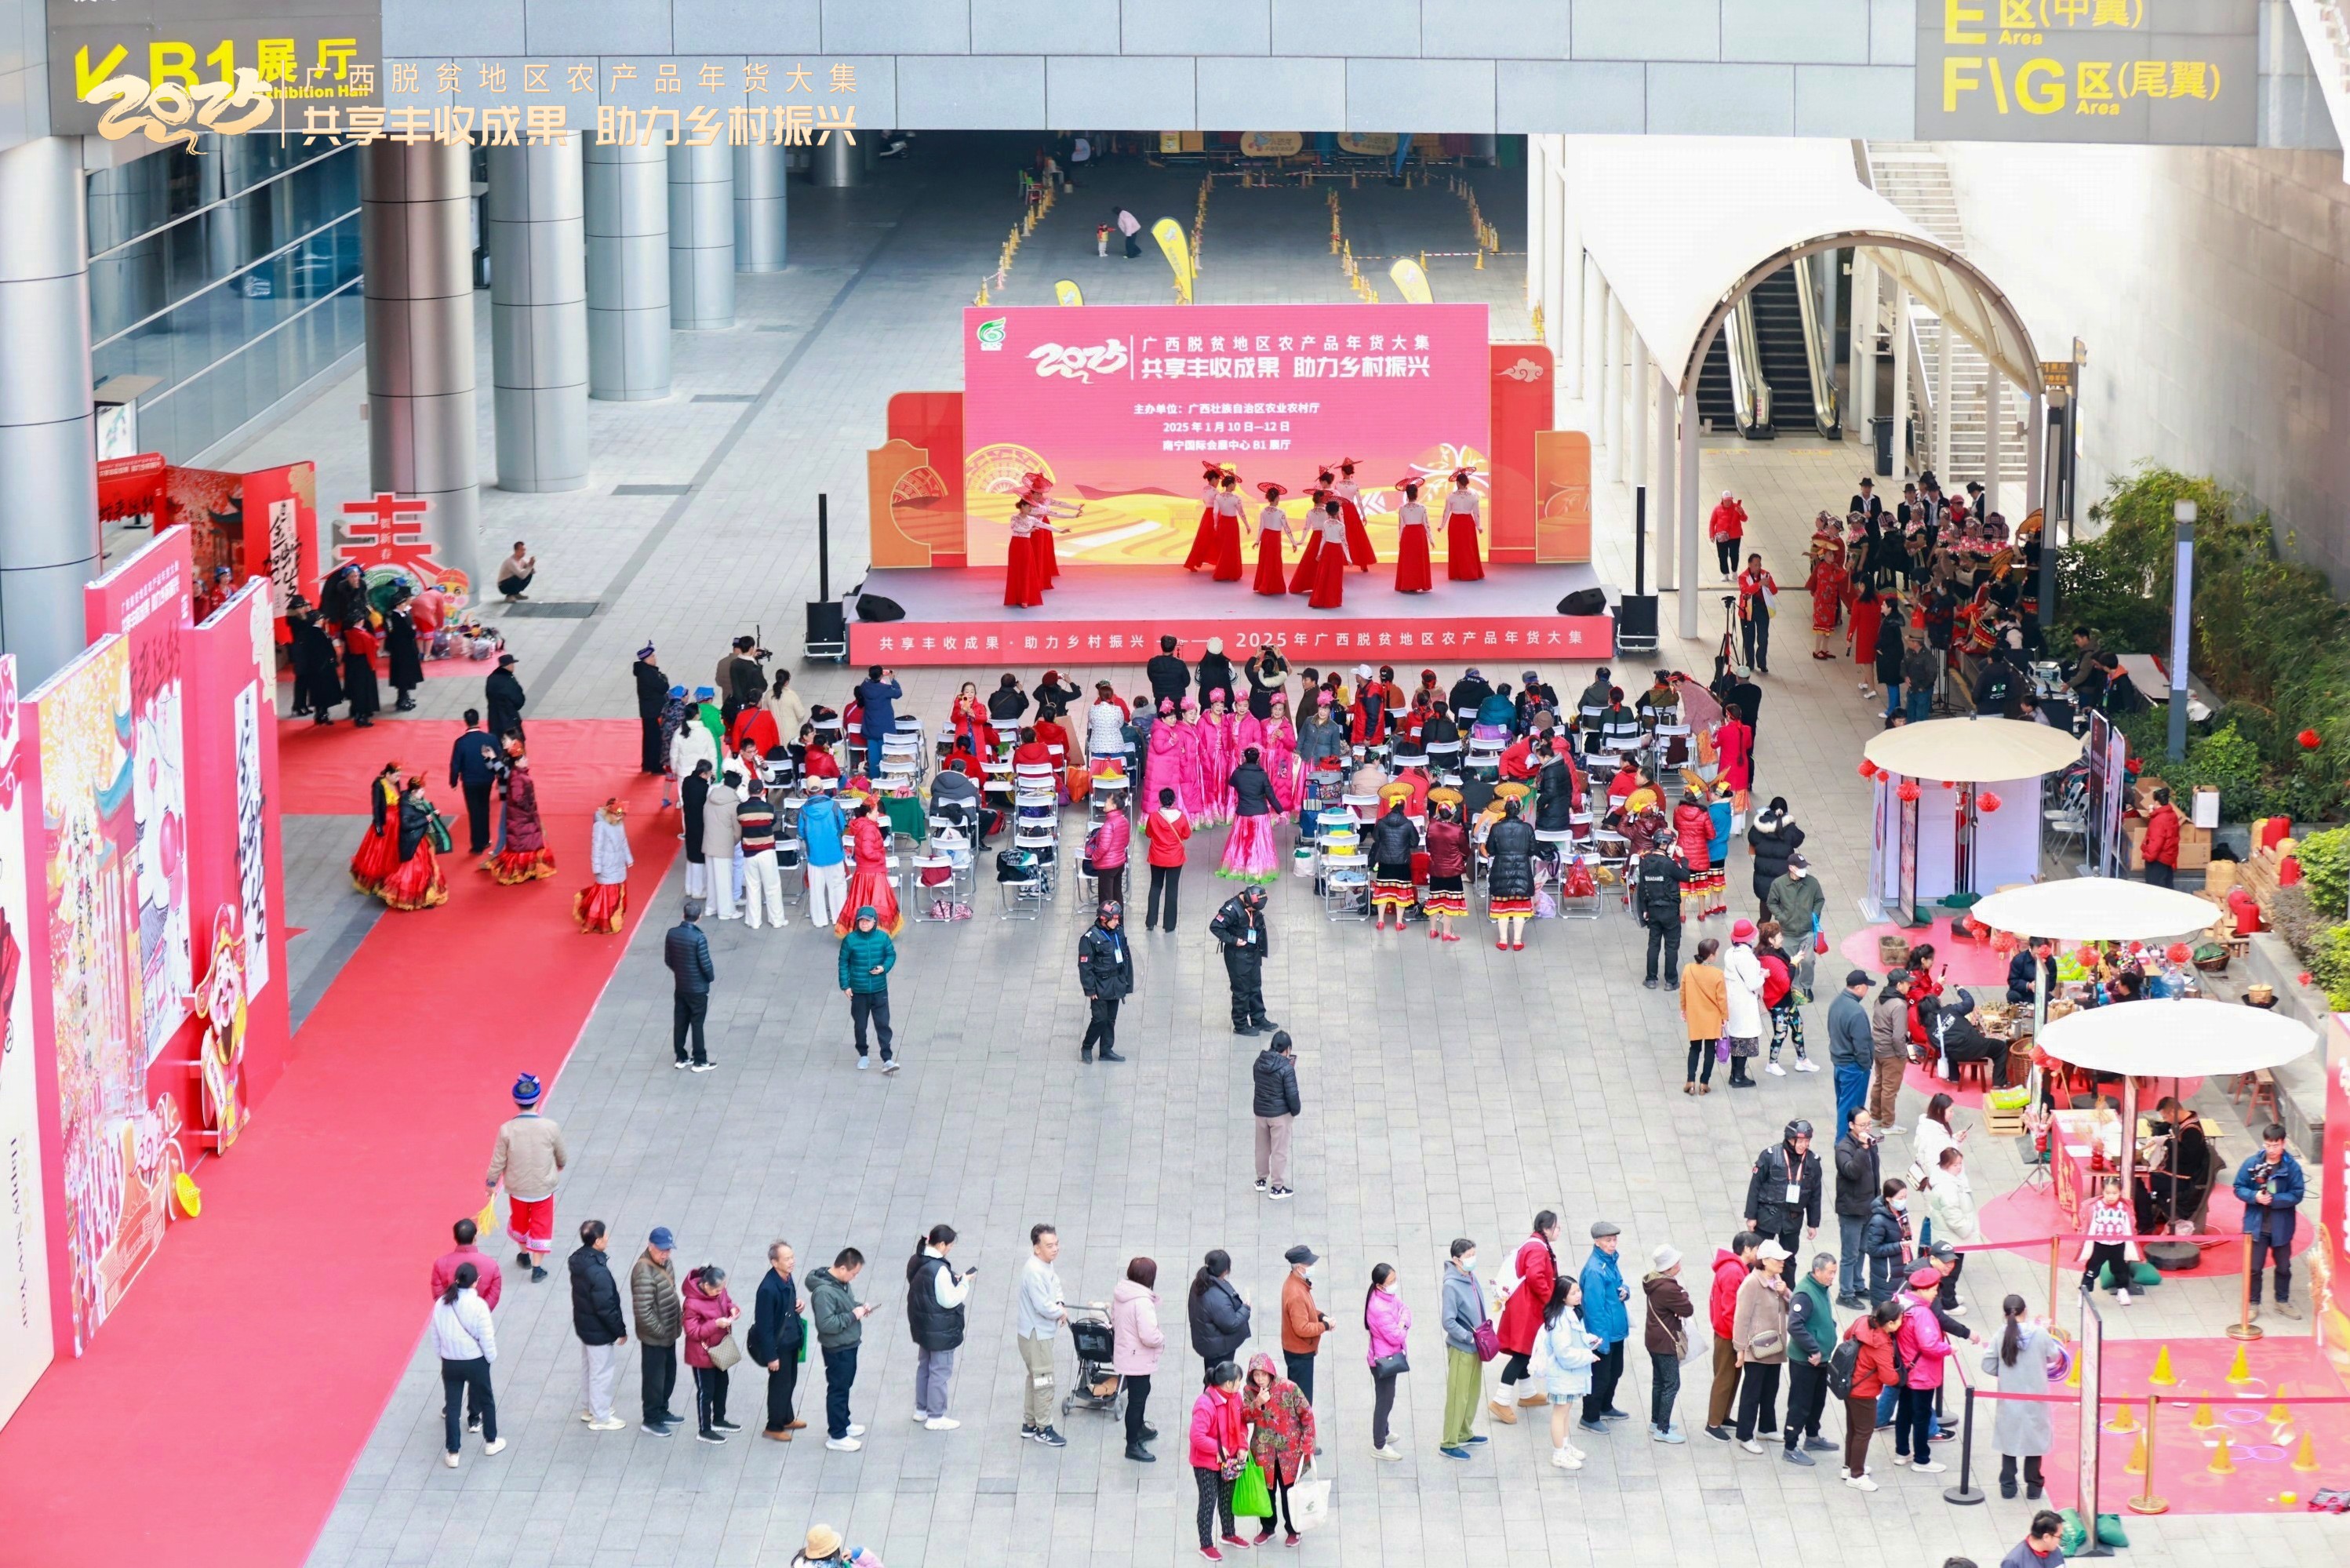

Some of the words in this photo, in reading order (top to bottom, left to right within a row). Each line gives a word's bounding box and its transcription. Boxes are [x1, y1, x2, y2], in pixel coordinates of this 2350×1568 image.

[1998, 29, 2043, 45] Area
[253, 84, 334, 100] xhibition
[2075, 99, 2120, 115] Area
[1142, 335, 1431, 352] 广西脱贫地区农产品年货大集
[1025, 338, 1130, 384] 2025
[1141, 356, 1280, 380] 共享丰收成果
[1293, 356, 1431, 380] 助力乡村振兴
